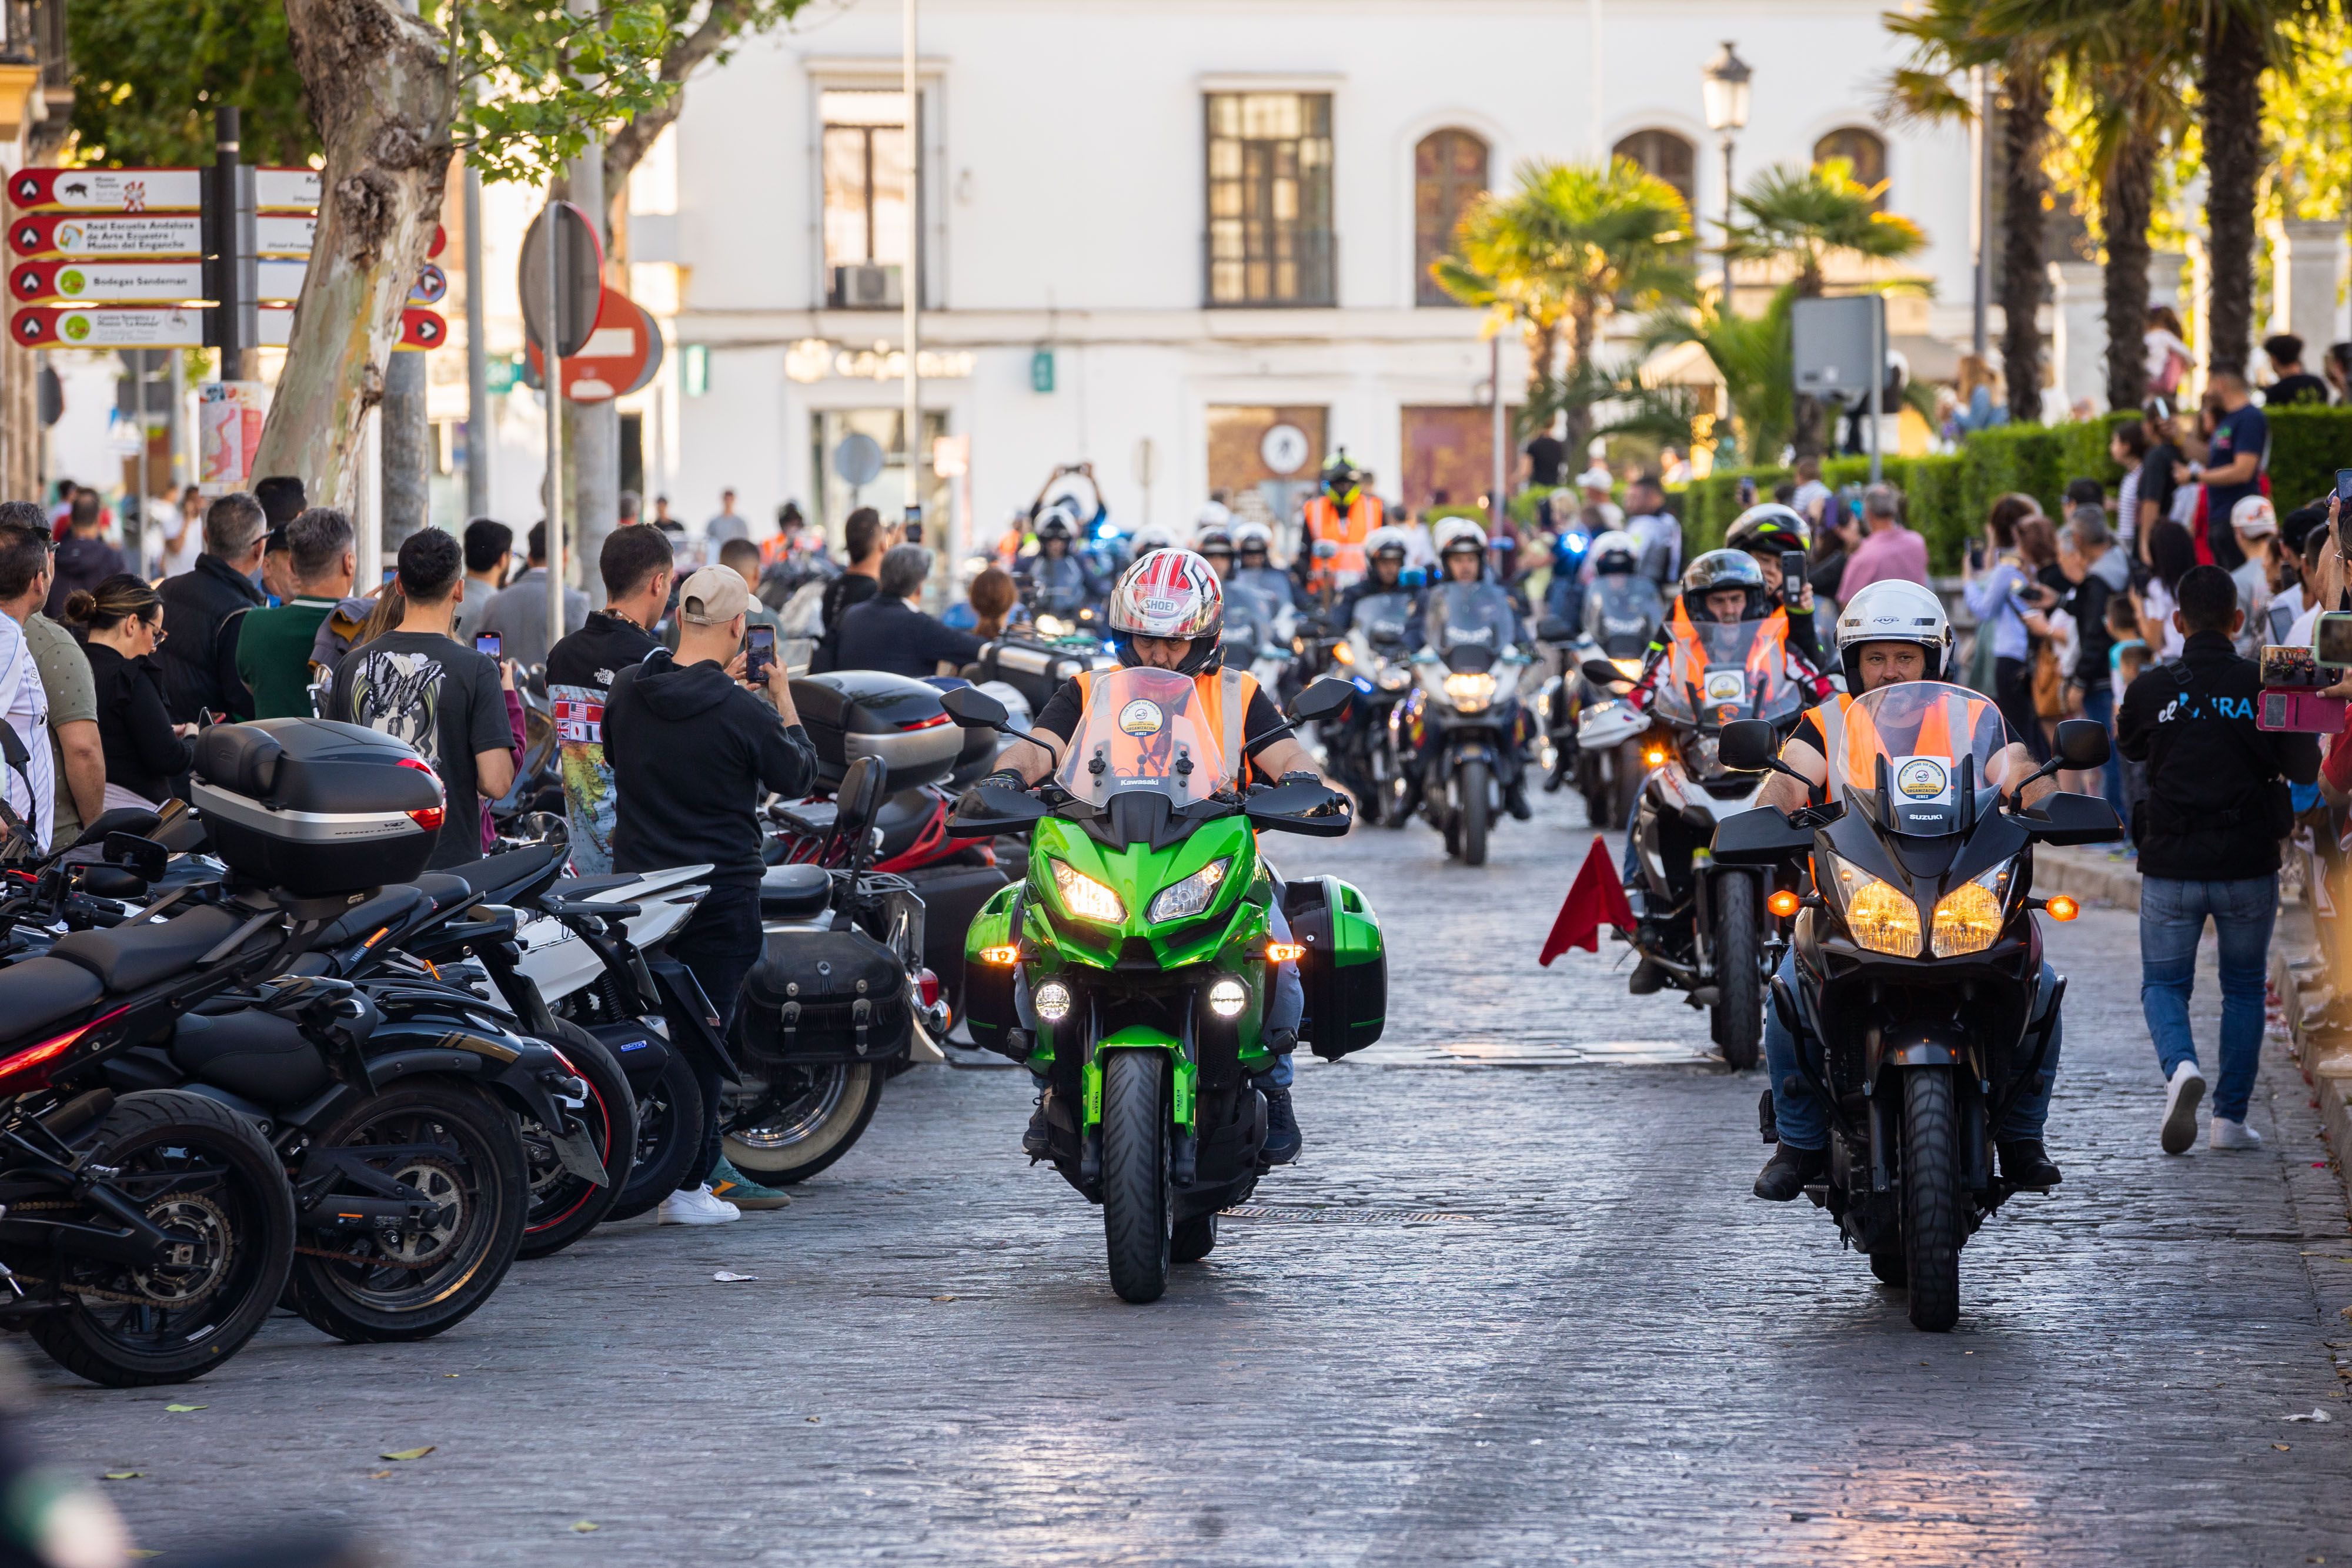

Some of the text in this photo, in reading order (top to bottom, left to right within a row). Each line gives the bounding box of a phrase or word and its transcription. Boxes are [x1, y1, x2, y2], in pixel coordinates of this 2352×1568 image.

[111, 222, 146, 230] Escuela
[102, 232, 123, 240] Arte
[139, 241, 185, 250] Enganche
[93, 277, 133, 287] Bodegas
[1144, 600, 1174, 611] SHOEI
[2158, 700, 2178, 723] el
[349, 946, 369, 962] YAMAHA
